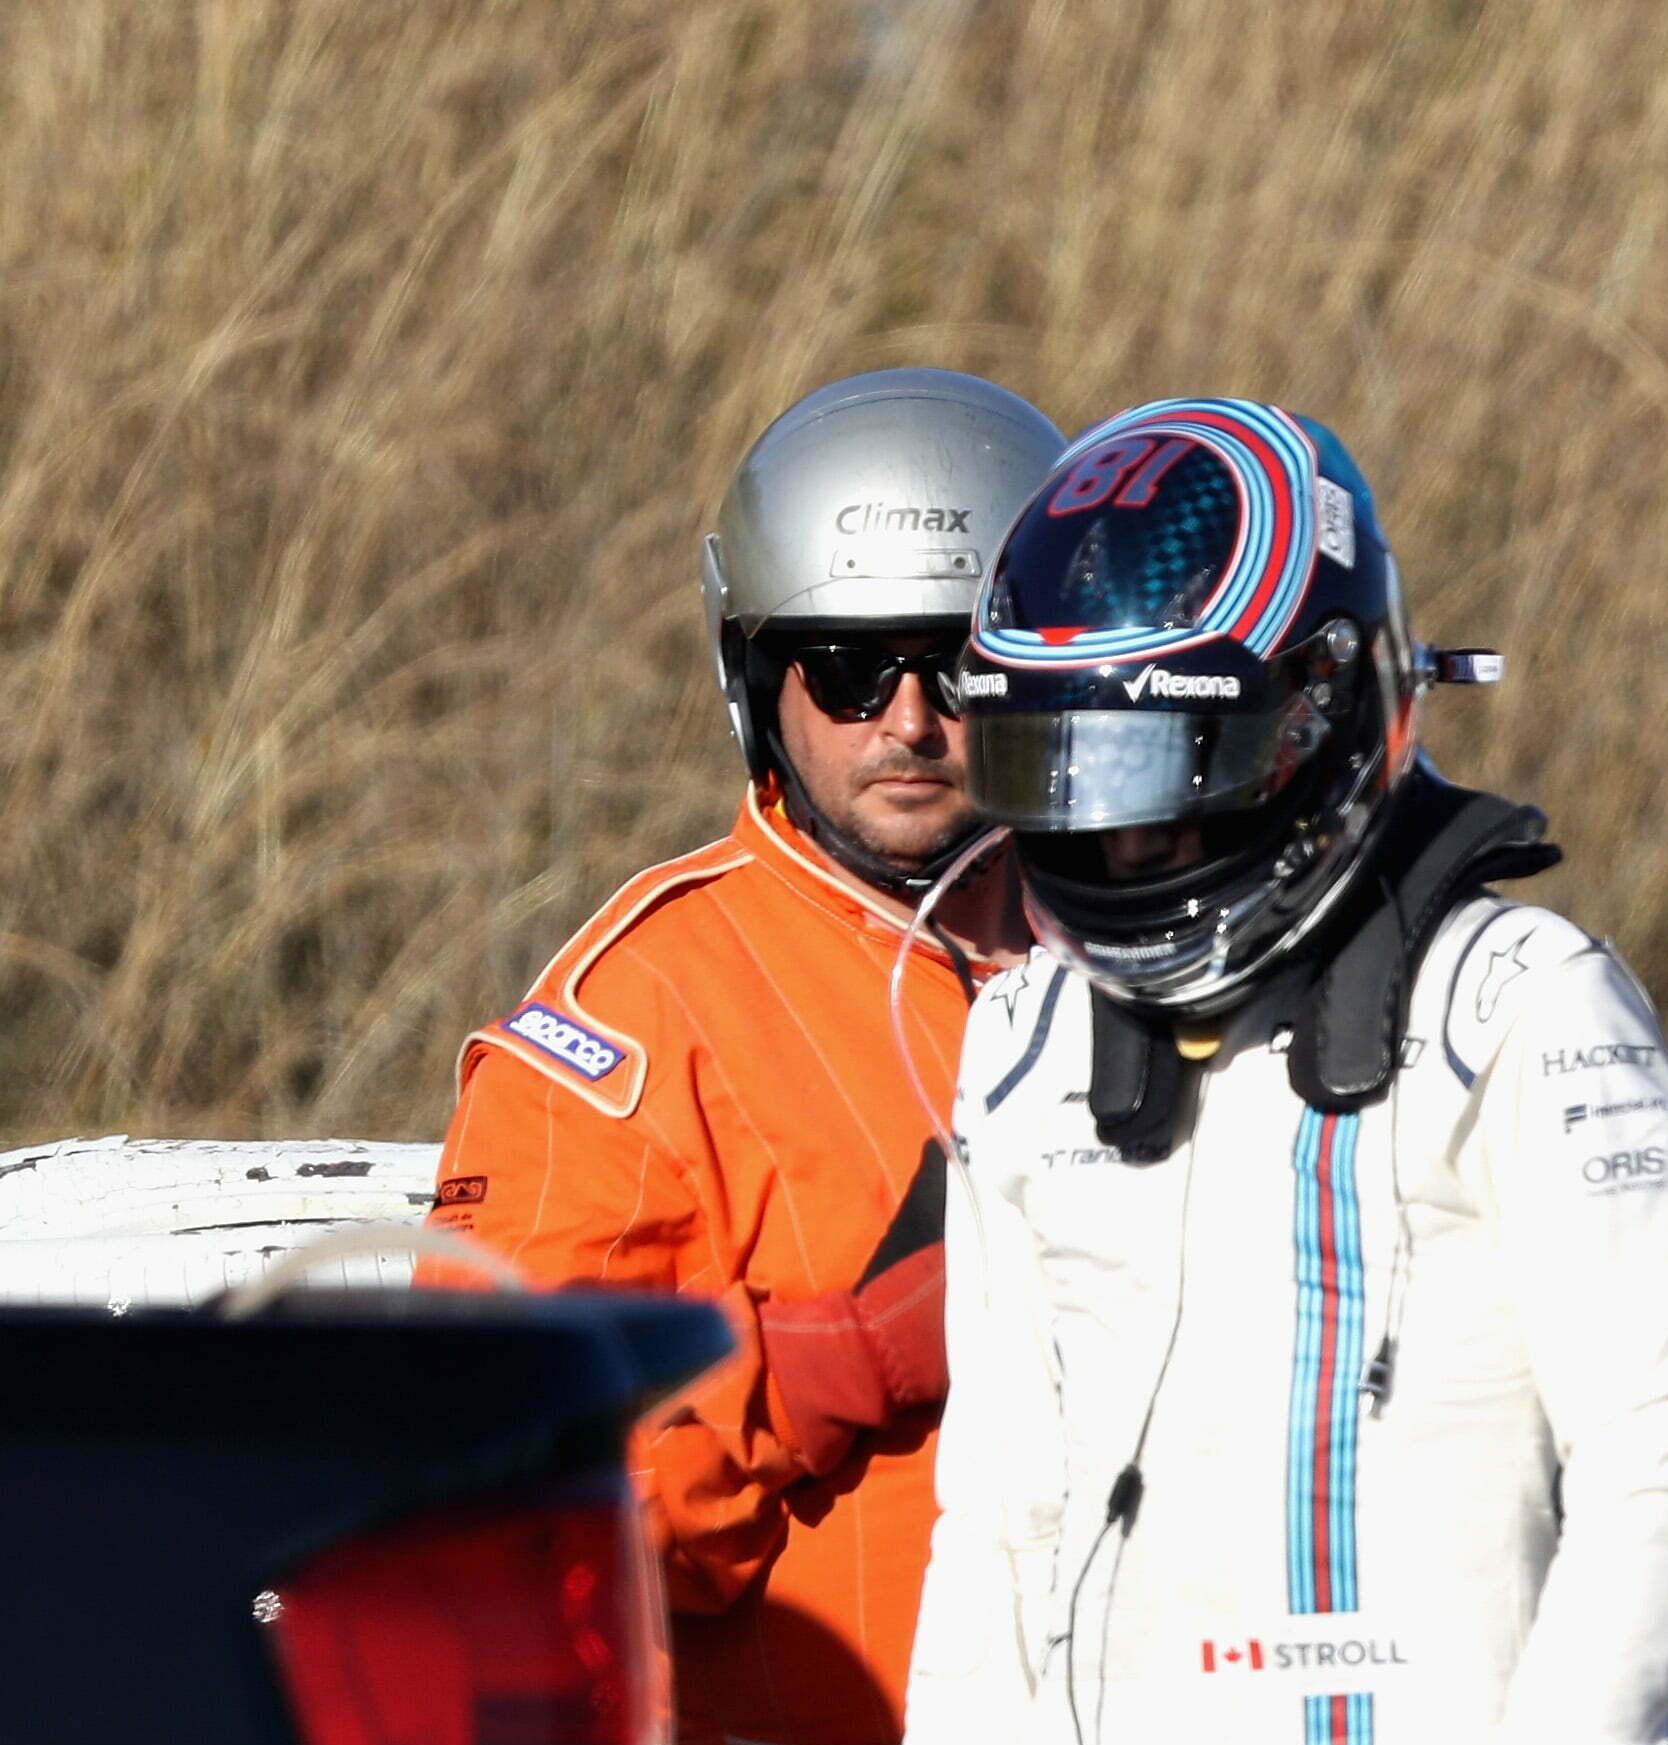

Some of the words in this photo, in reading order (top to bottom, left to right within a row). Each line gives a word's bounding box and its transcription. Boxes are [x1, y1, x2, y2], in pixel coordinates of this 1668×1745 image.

[835, 502, 973, 535] Climax
[1150, 669, 1242, 699] Rexona
[509, 1010, 615, 1076] sparco
[1582, 1147, 1665, 1184] ORIS
[1274, 1640, 1408, 1669] STROLL
